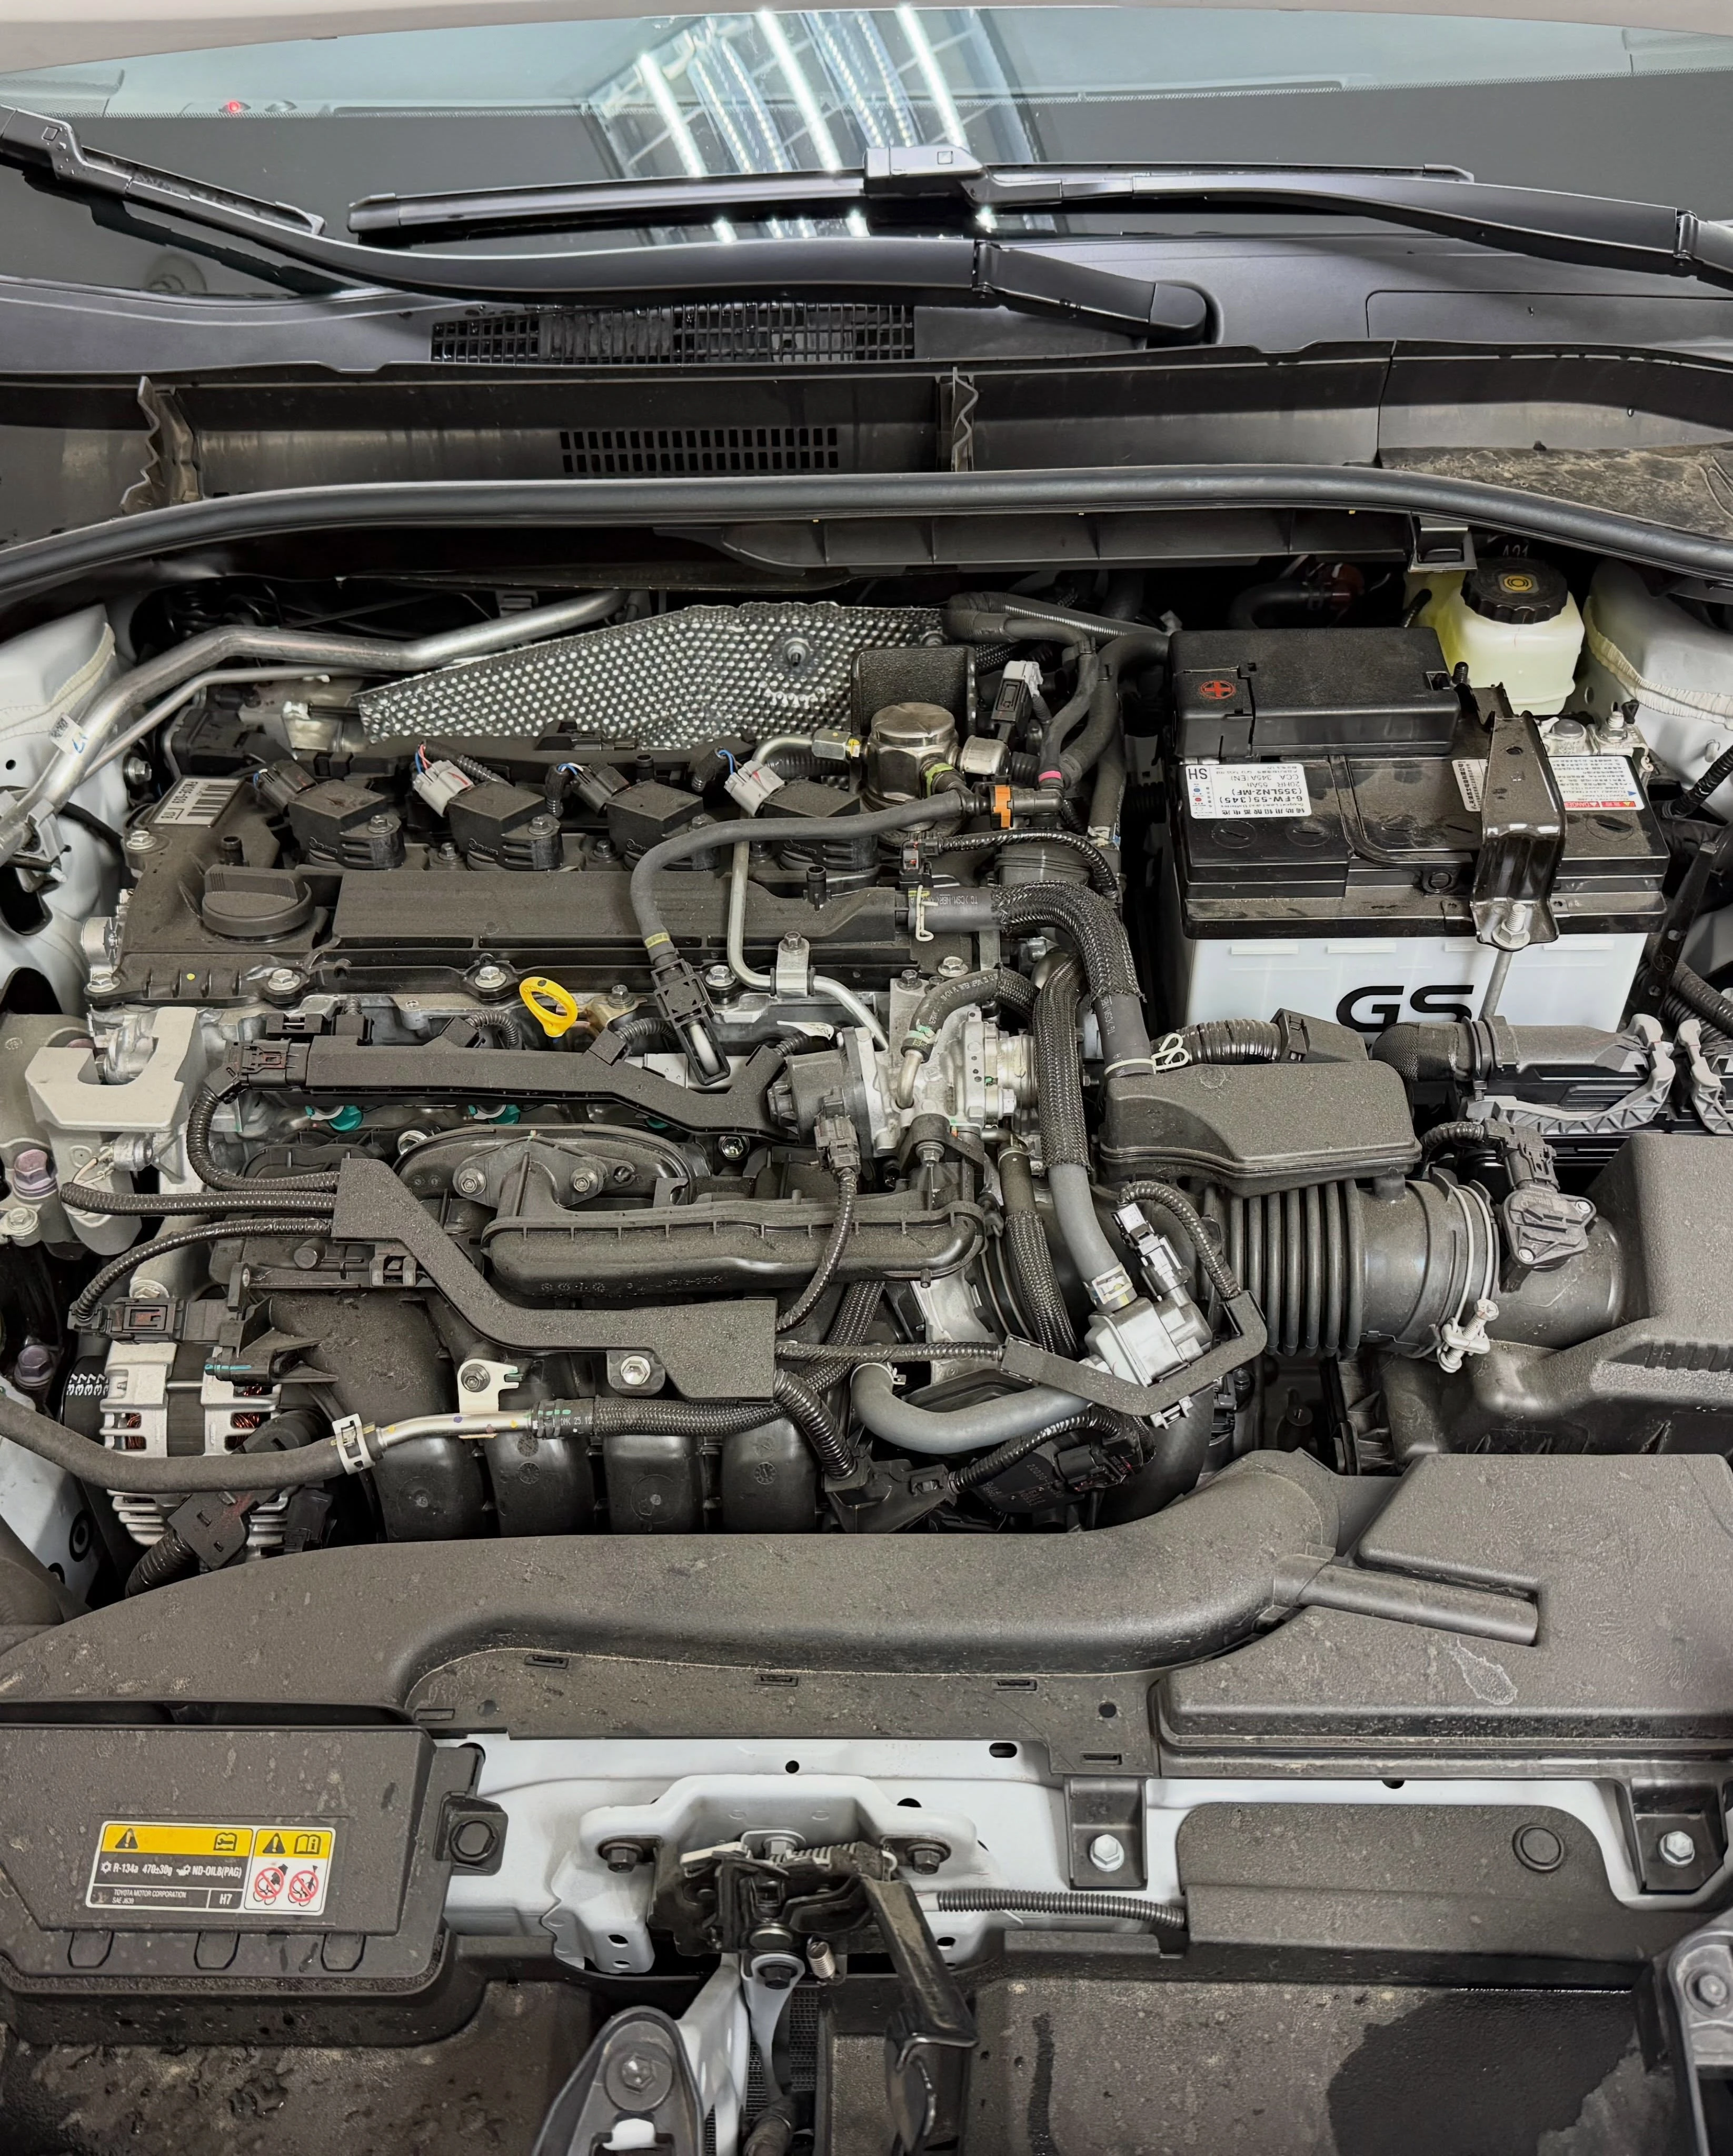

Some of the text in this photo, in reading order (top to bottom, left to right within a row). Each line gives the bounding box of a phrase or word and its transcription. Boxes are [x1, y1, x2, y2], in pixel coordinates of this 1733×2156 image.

[1337, 985, 1474, 1032] GS
[113, 1863, 242, 1879] R-134a 470±30g ND-OIL8(PAG)
[114, 1889, 134, 1897] TOYOTA
[150, 1890, 186, 1899] CORPORATION
[218, 1893, 233, 1905] H7
